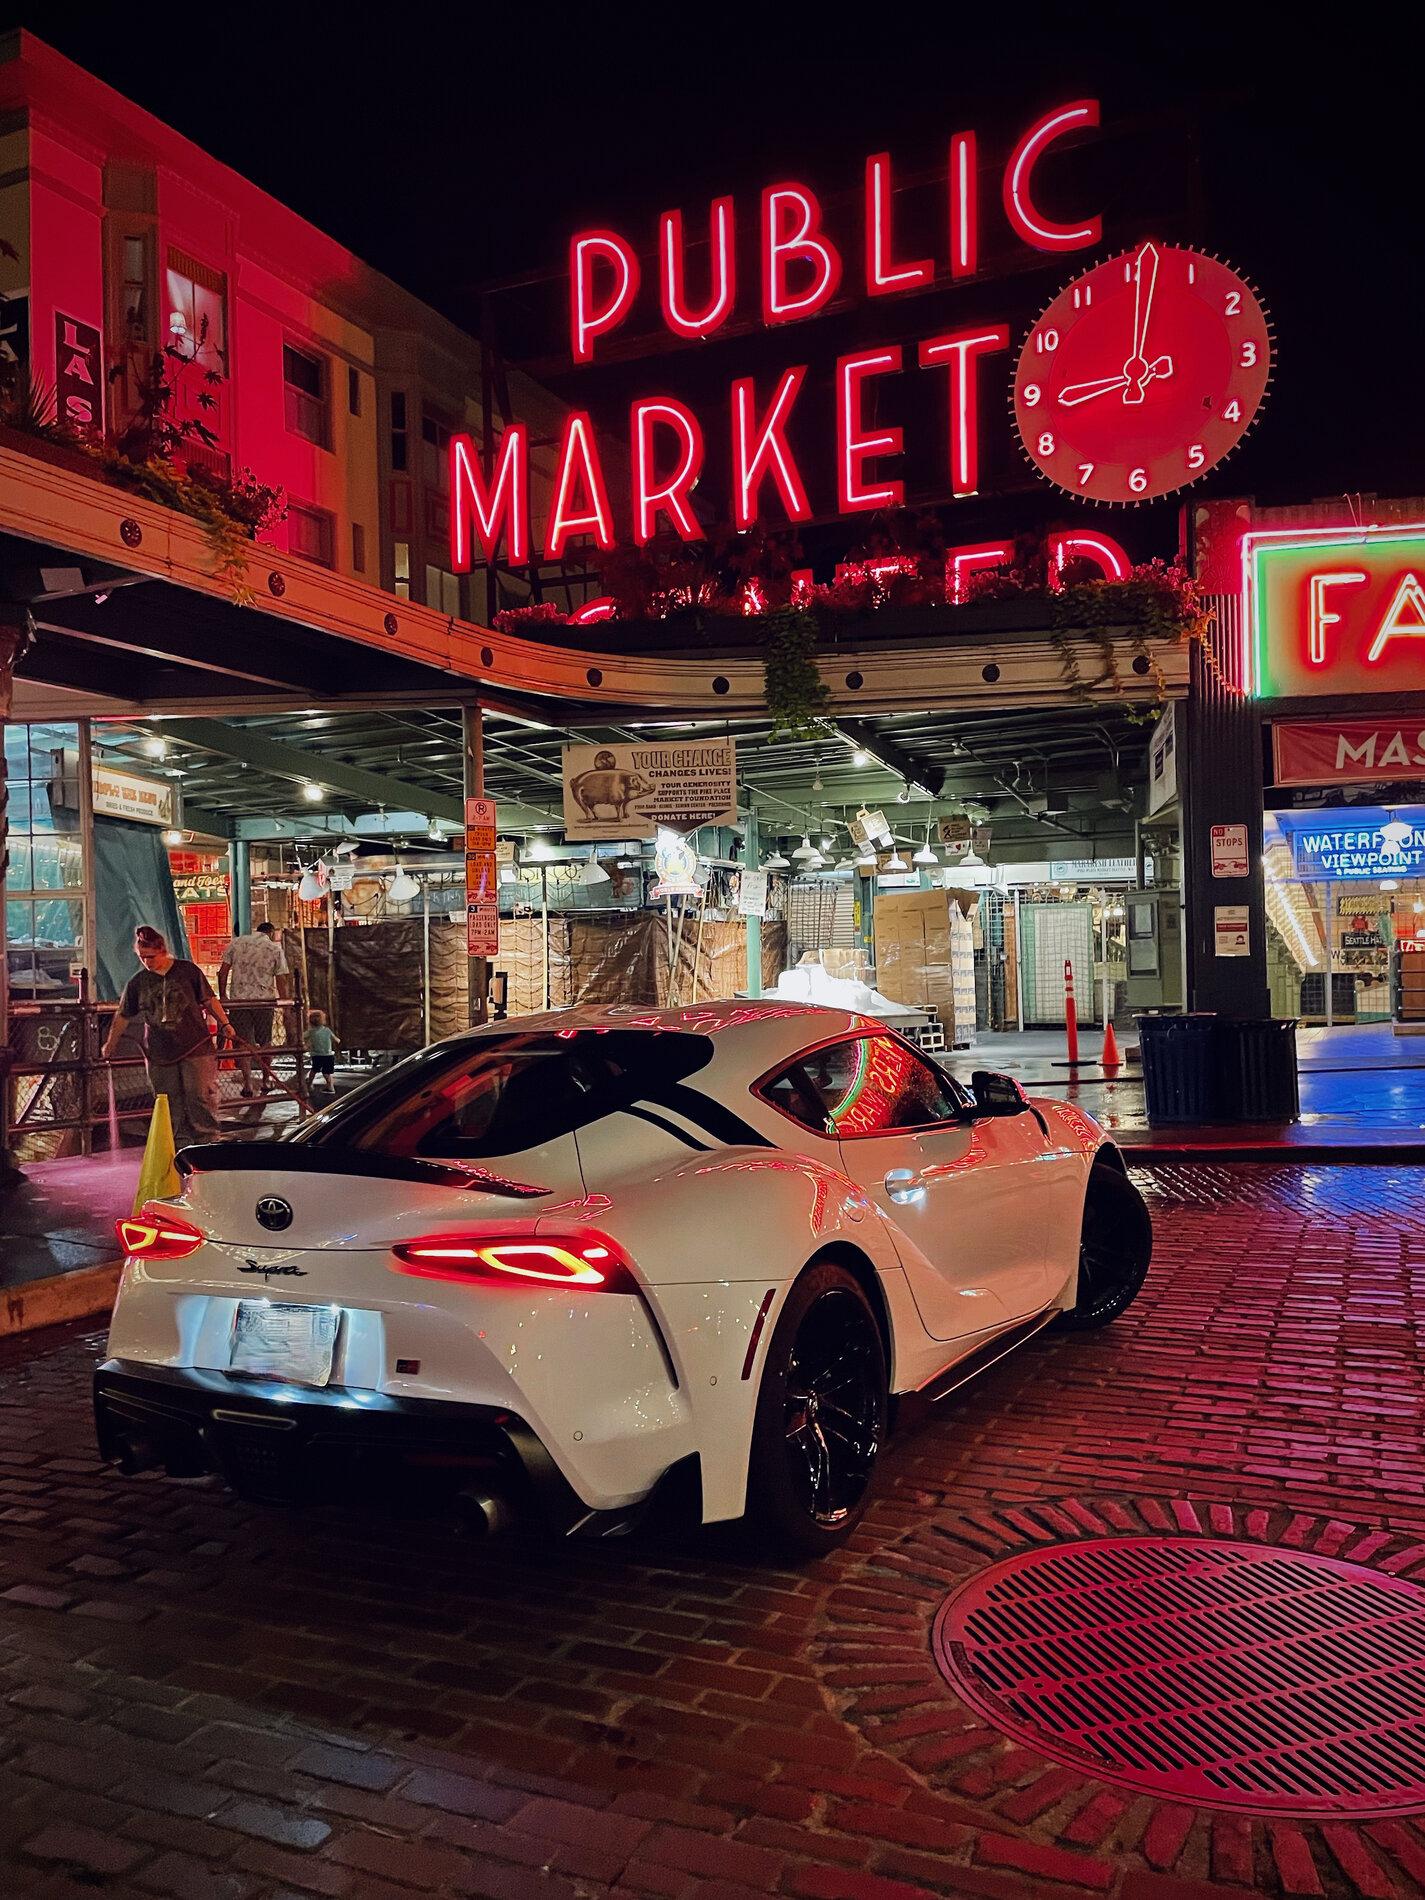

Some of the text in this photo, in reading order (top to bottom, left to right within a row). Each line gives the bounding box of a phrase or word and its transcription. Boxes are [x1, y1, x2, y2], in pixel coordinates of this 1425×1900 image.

[570, 99, 1101, 363] PUBLIC
[1073, 285, 1093, 309] 11
[1224, 291, 1242, 316] 2
[1036, 328, 1060, 354] 10
[1239, 341, 1258, 368] 3
[1023, 384, 1042, 408] 9
[1223, 400, 1242, 424] 4
[450, 323, 1009, 574] MARKET
[1037, 432, 1056, 457] 8
[1188, 445, 1206, 470] 5
[1077, 463, 1095, 486] 7
[1127, 467, 1147, 493] 6
[631, 748, 732, 770] YOUR CHANGE
[648, 767, 732, 778] CHANGES LIVES!
[651, 812, 716, 822] DONATE HERE!
[1213, 827, 1224, 837] NO
[1215, 837, 1243, 847] STOPS
[1302, 829, 1425, 854] WATERFON
[1321, 850, 1423, 869] VIEWPOINT
[1343, 867, 1371, 875] PUBLIC
[173, 876, 197, 888] and
[1344, 936, 1370, 945] SEATTLE
[236, 1258, 309, 1283] Supra
